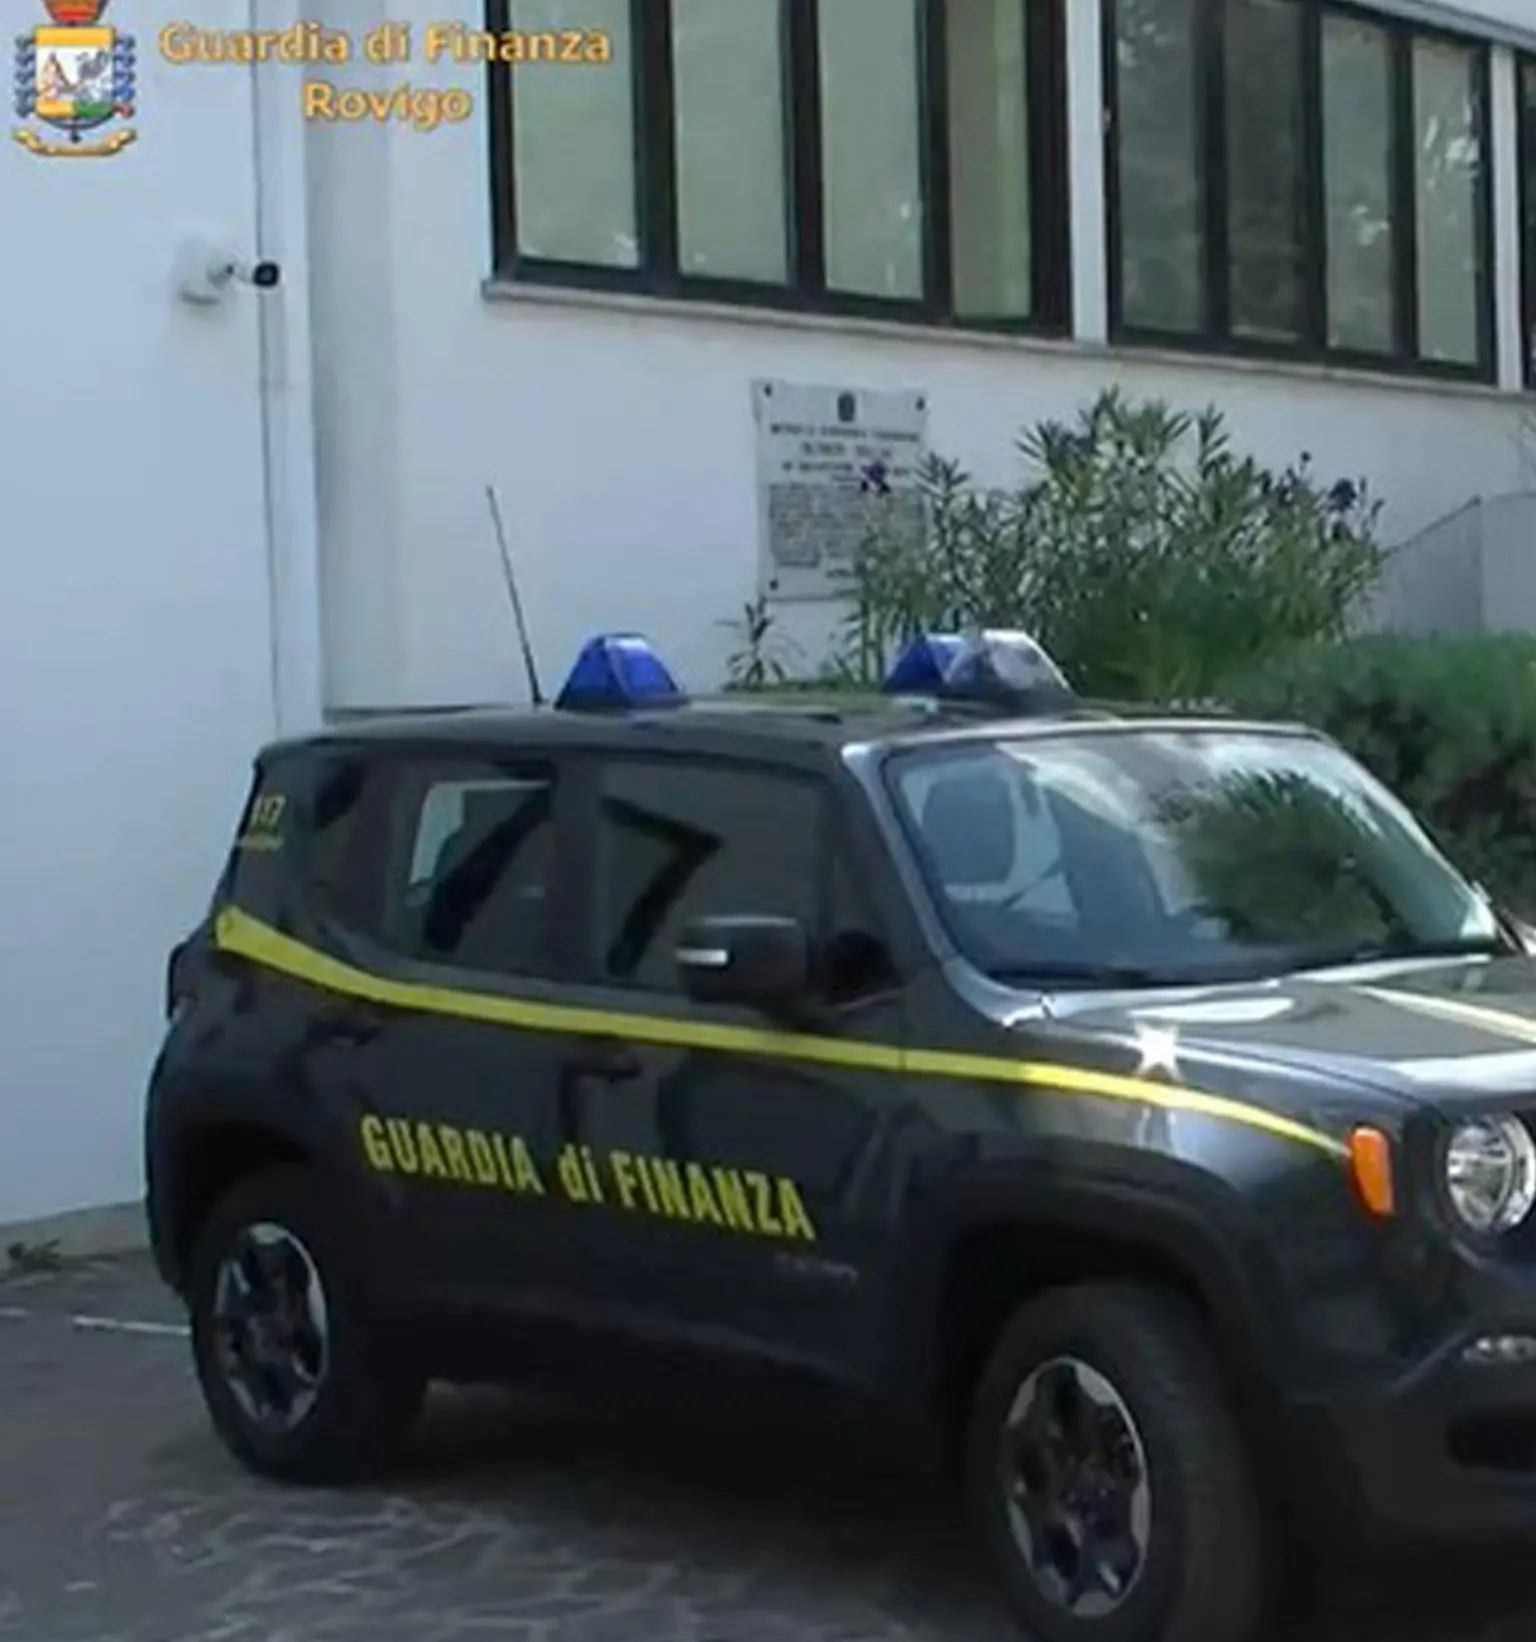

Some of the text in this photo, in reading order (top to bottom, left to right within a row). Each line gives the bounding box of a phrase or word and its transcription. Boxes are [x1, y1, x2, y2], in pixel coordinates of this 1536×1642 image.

[361, 1113, 816, 1241] GUARDIA di FINANZA
